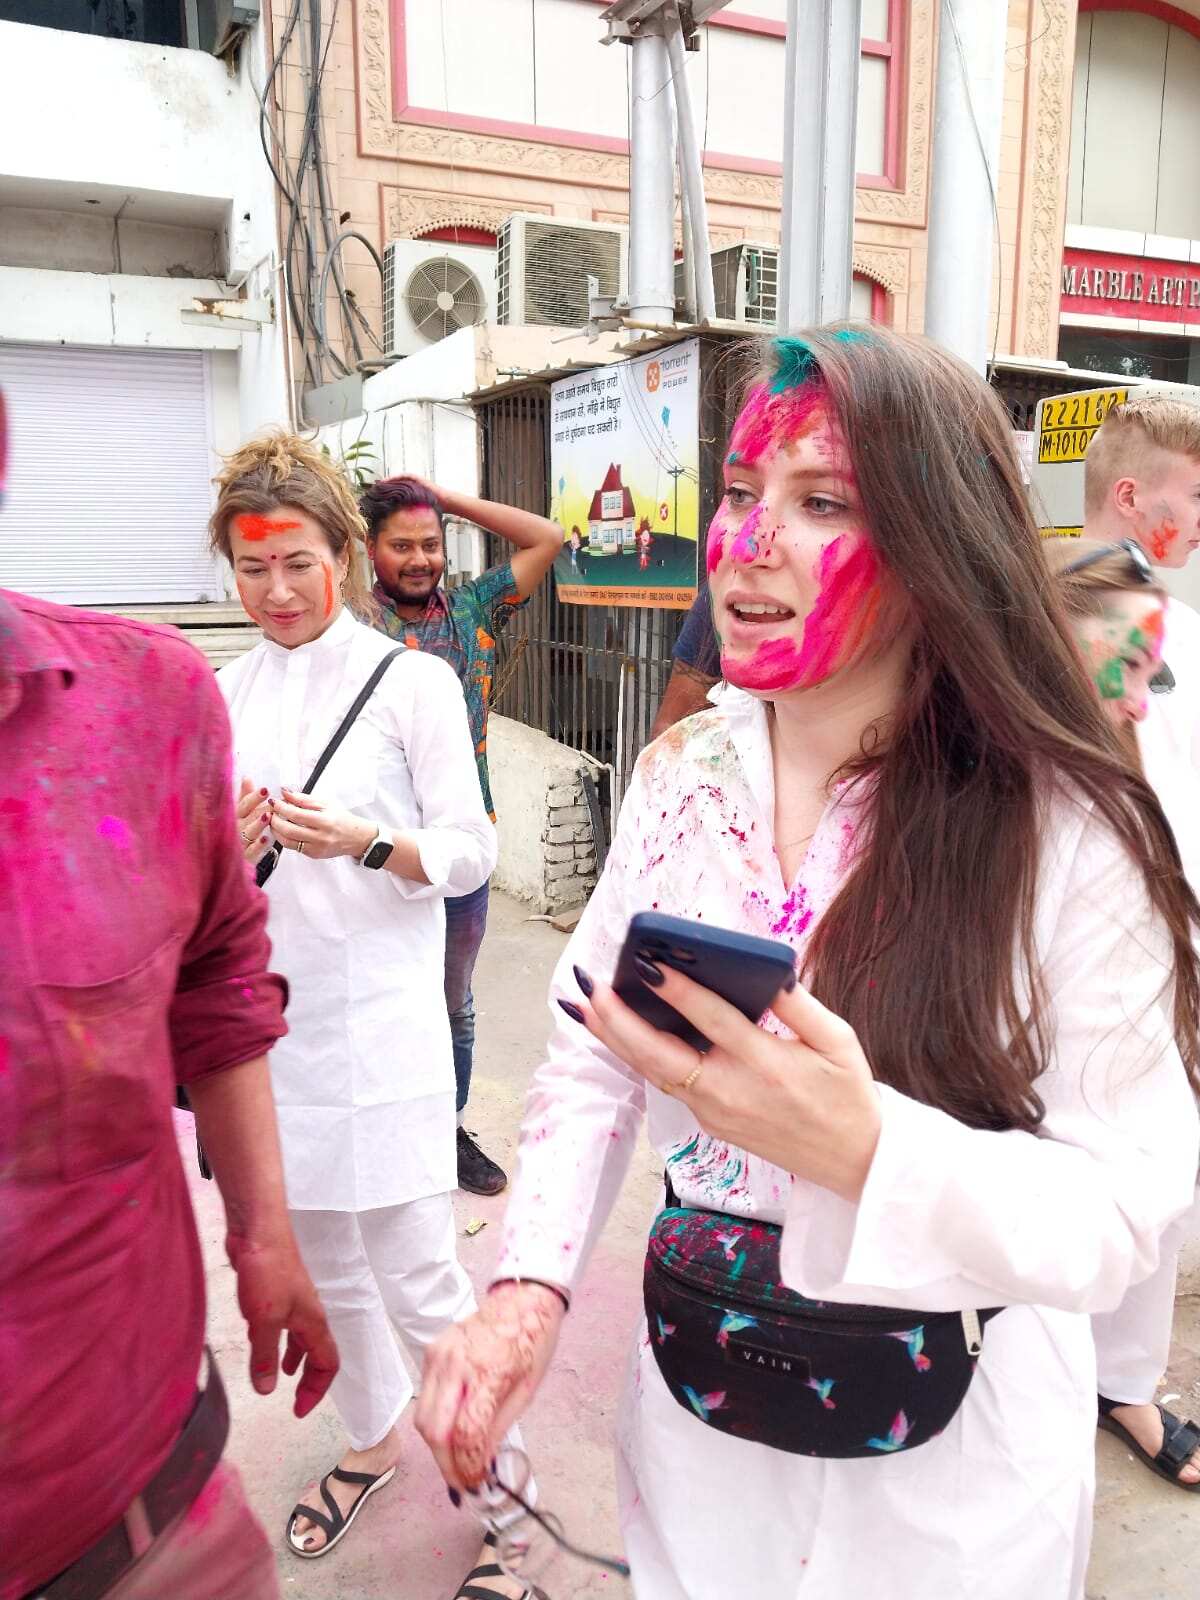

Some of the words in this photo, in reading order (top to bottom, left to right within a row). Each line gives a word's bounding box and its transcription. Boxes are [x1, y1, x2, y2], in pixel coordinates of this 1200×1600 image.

[1061, 264, 1145, 301] MARBLE
[1146, 274, 1187, 306] ART
[660, 351, 691, 372] torrent
[743, 1351, 792, 1371] VAIN
